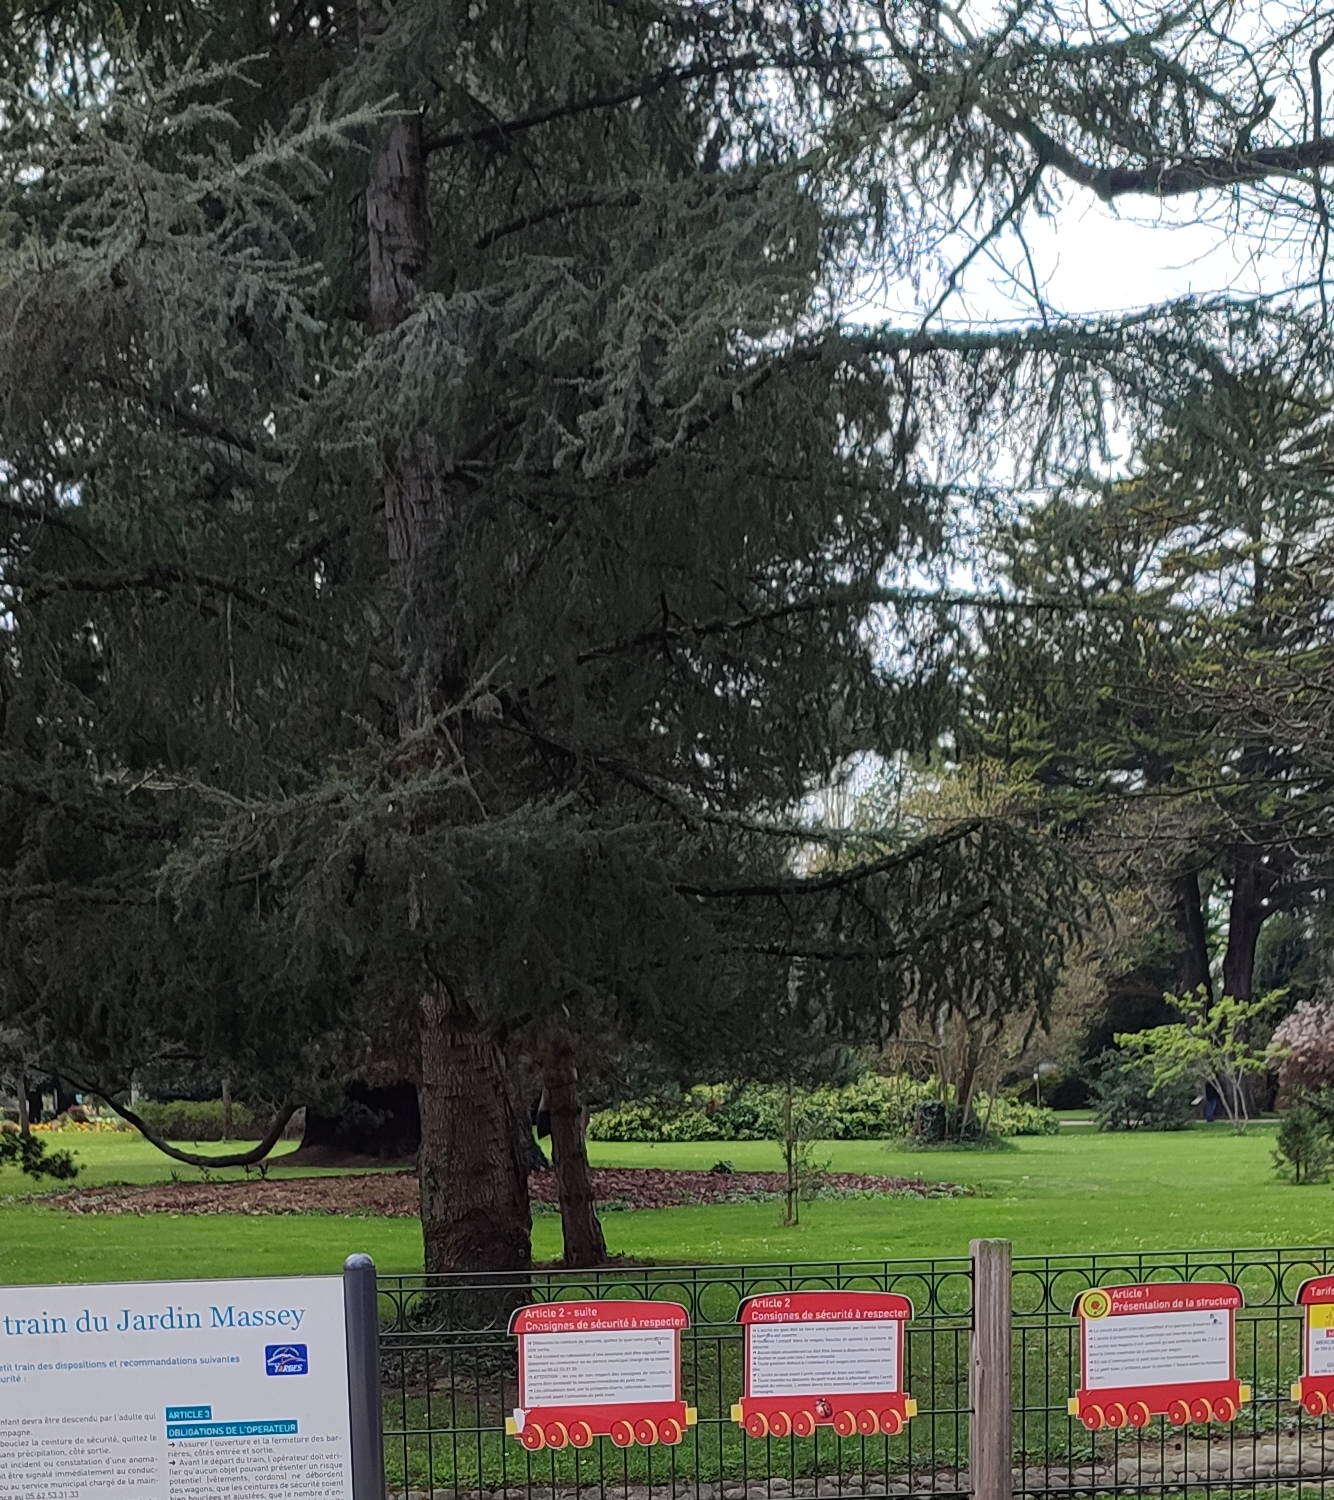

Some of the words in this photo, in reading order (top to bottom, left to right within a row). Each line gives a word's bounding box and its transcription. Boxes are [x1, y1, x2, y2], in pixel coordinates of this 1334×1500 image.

[1112, 1286, 1142, 1299] Article
[1143, 1286, 1150, 1297] 1
[751, 1297, 782, 1308] Article
[784, 1297, 791, 1307] 2
[1112, 1298, 1170, 1311] Présentation
[1171, 1297, 1183, 1308] de
[1185, 1296, 1194, 1307] la
[1195, 1294, 1238, 1307] structure
[524, 1307, 556, 1319] Article
[558, 1307, 564, 1317] 2
[573, 1305, 598, 1317] suite
[751, 1309, 800, 1323] Consignes
[801, 1309, 813, 1320] de
[814, 1308, 853, 1319] sécurité
[854, 1308, 860, 1318] à
[861, 1306, 908, 1320] respecter
[3, 1311, 68, 1336] train
[76, 1309, 109, 1333] du
[117, 1306, 202, 1331] Jardin
[209, 1305, 306, 1331] Massey
[525, 1319, 575, 1333] Consignes
[576, 1318, 588, 1329] de
[589, 1317, 629, 1329] sécurité
[630, 1317, 637, 1328] à
[638, 1315, 685, 1329] respecter
[14, 1361, 35, 1371] train
[37, 1360, 53, 1370] des
[54, 1358, 107, 1372] dispositions
[108, 1357, 117, 1368] et
[118, 1354, 197, 1367] recommandations
[199, 1352, 240, 1364] suivantes
[168, 1410, 203, 1419] ARTICLE
[204, 1410, 210, 1418] 3
[169, 1426, 224, 1437] OBLIGATIONS
[225, 1426, 237, 1434] DE
[238, 1423, 296, 1434] L'OPERATEUR
